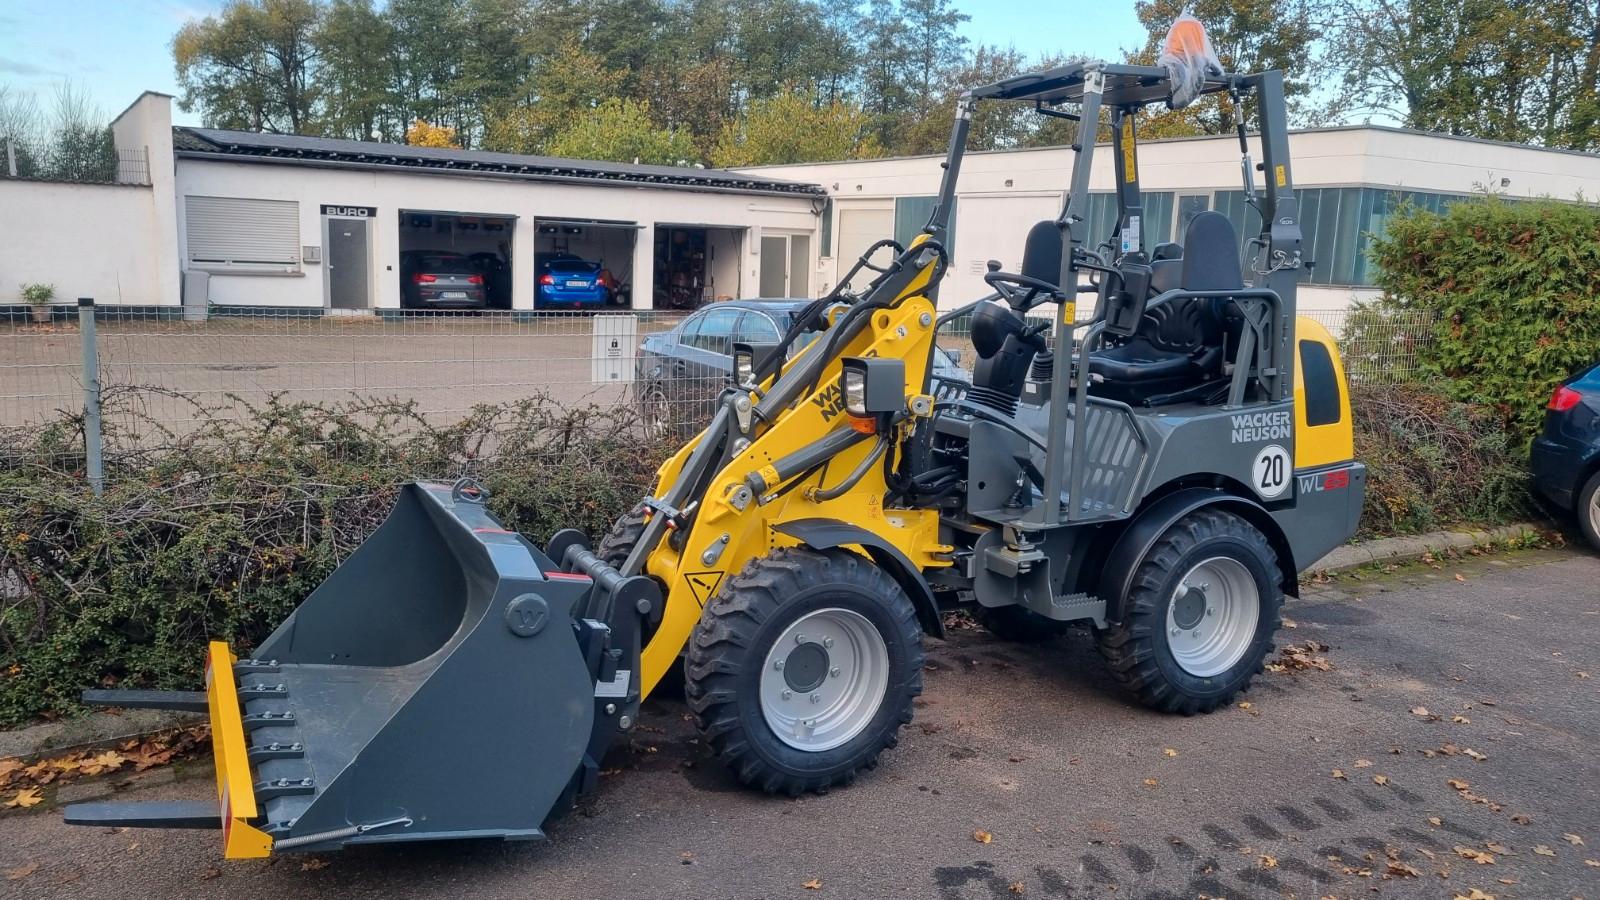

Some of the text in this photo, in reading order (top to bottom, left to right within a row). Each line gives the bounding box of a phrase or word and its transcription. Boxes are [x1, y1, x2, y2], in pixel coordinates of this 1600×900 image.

[1231, 411, 1291, 429] WACKER
[1231, 424, 1291, 444] NEUSON
[1261, 454, 1284, 488] 20
